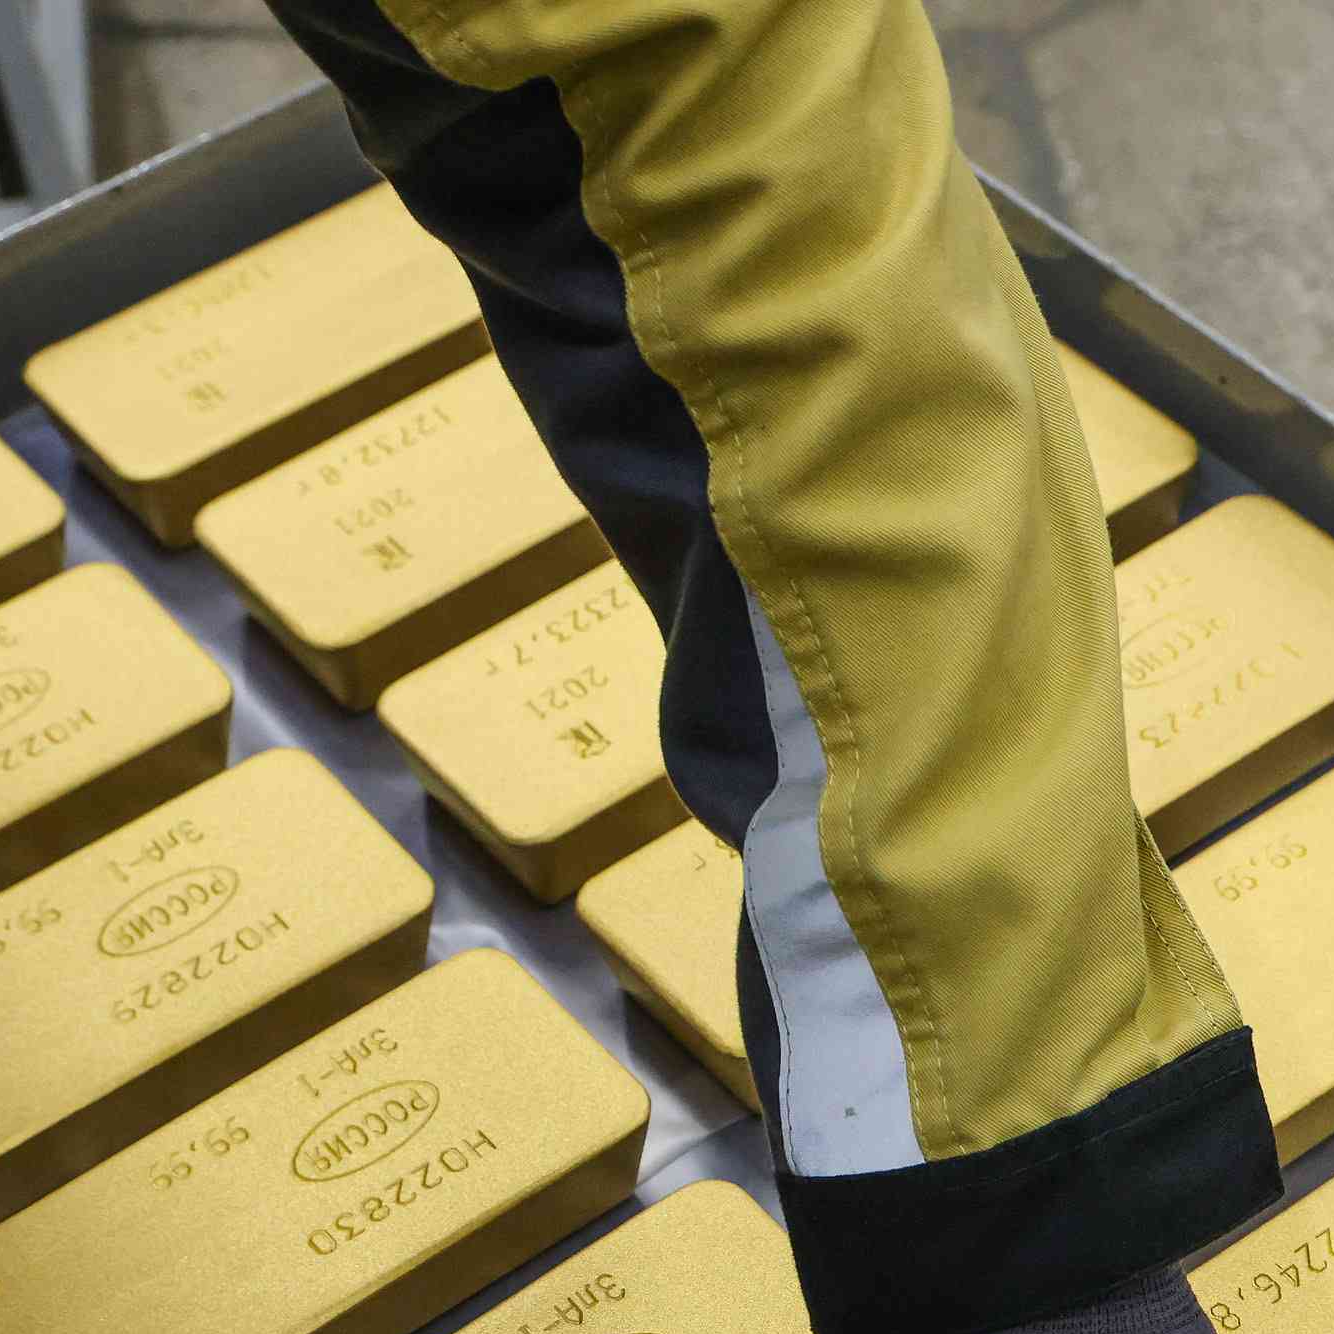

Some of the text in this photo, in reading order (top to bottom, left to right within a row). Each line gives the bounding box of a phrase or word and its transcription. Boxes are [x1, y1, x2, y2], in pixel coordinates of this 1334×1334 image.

[506, 582, 631, 669] 2323,7
[520, 661, 611, 724] 2021
[110, 870, 228, 952] РОССИЯ
[303, 1084, 430, 1176] РОССИЯ
